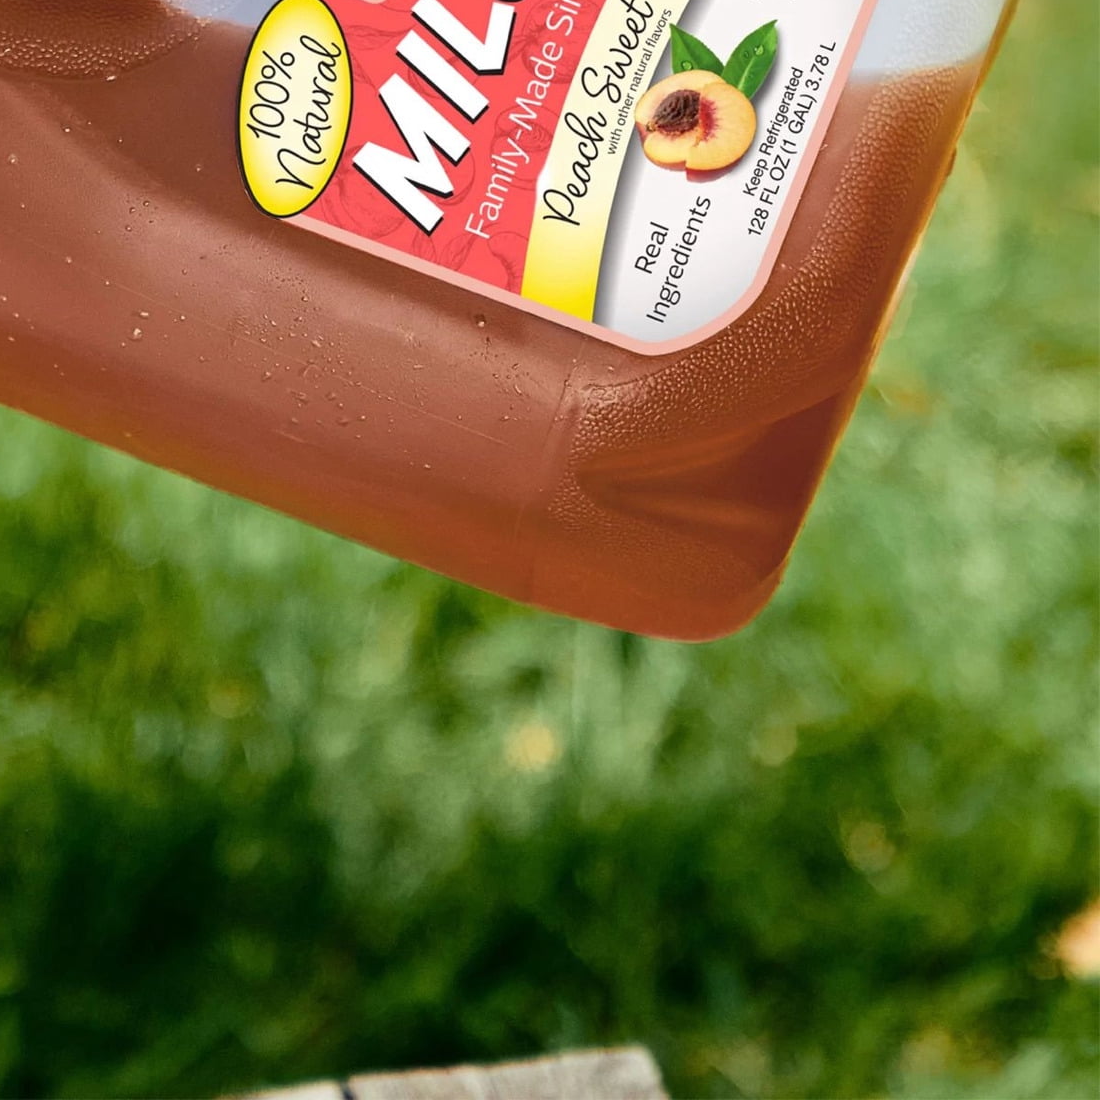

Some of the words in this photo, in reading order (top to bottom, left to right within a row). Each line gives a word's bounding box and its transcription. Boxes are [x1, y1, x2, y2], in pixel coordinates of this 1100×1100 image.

[805, 54, 830, 91] 3.78
[820, 42, 836, 51] L
[246, 49, 295, 139] 100%
[607, 128, 623, 155] with
[617, 92, 634, 126] other
[630, 48, 652, 93] natural
[645, 9, 672, 48] flavors
[275, 35, 342, 190] Natural
[742, 158, 769, 196] Keep
[759, 66, 804, 156] Refrigerated
[788, 94, 817, 134] GAL)
[464, 41, 564, 239] Family-Made
[780, 139, 798, 154] (1
[542, 112, 608, 226] Peach
[769, 154, 790, 181] OZ
[747, 207, 769, 235] 128
[759, 185, 780, 205] FL
[634, 221, 670, 274] Real
[646, 195, 711, 323] Ingredients
